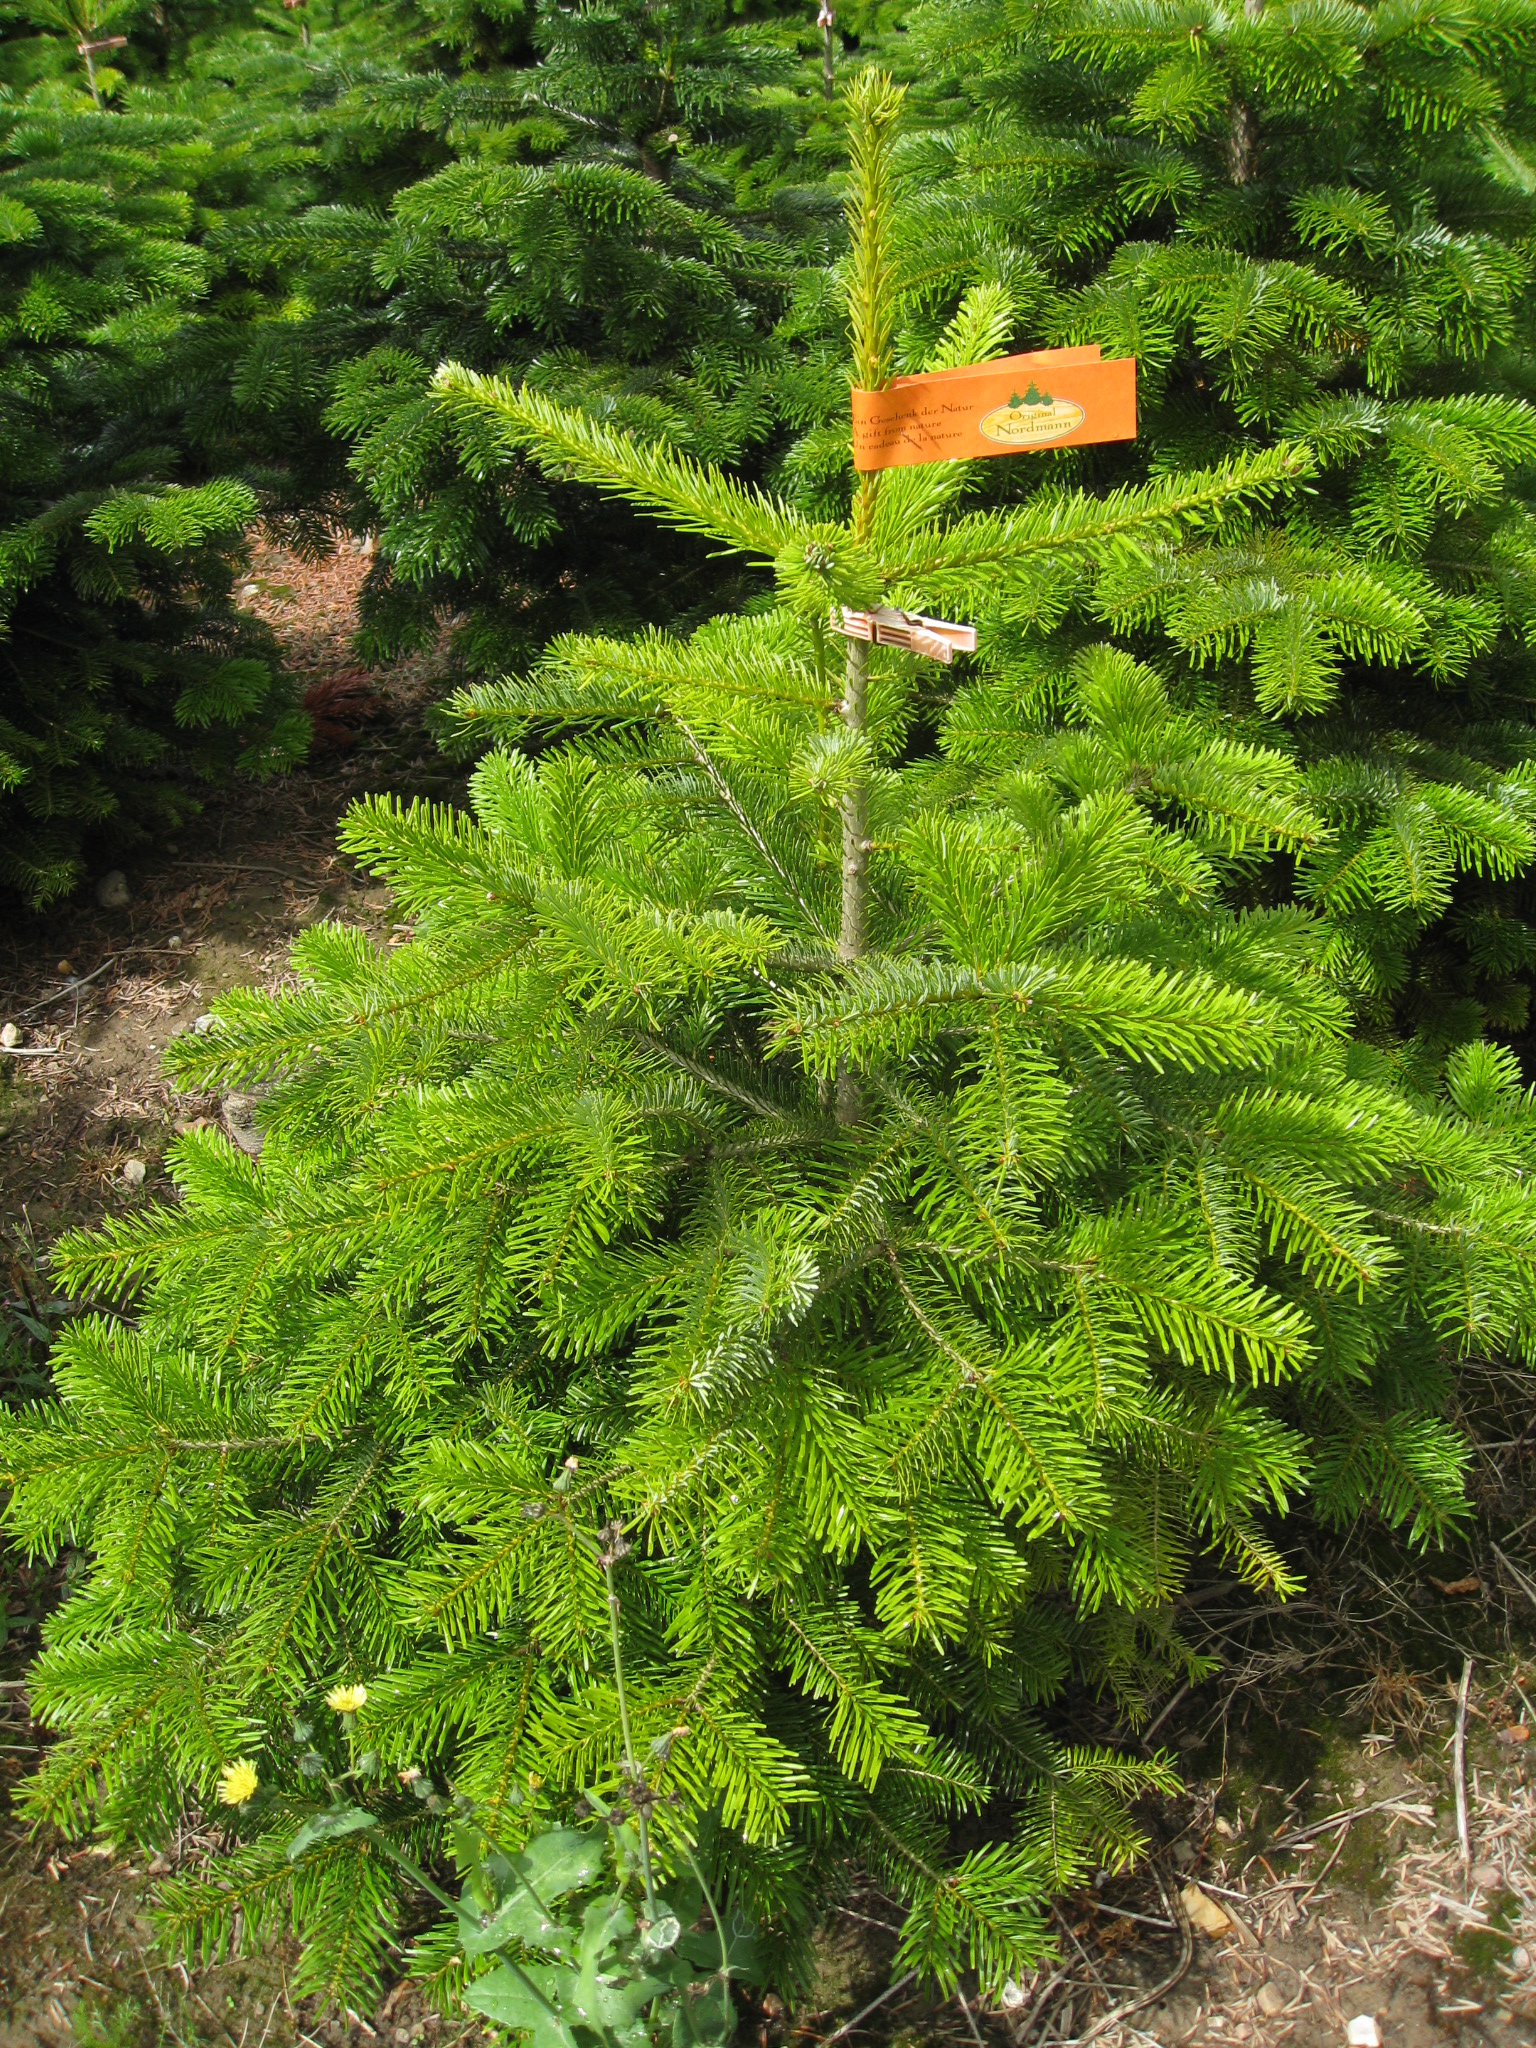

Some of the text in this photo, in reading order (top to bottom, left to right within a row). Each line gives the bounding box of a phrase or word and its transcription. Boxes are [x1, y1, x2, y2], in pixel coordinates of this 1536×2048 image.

[870, 408, 918, 425] Geschenk
[921, 406, 939, 416] der
[941, 403, 975, 414] Natur
[1009, 407, 1056, 421] Original
[863, 428, 881, 440] gift
[884, 426, 906, 436] from
[910, 421, 942, 431] nature
[996, 421, 1072, 437] Nordmann
[869, 439, 901, 450] cadeau
[919, 433, 928, 442] la
[930, 431, 963, 441] nature
